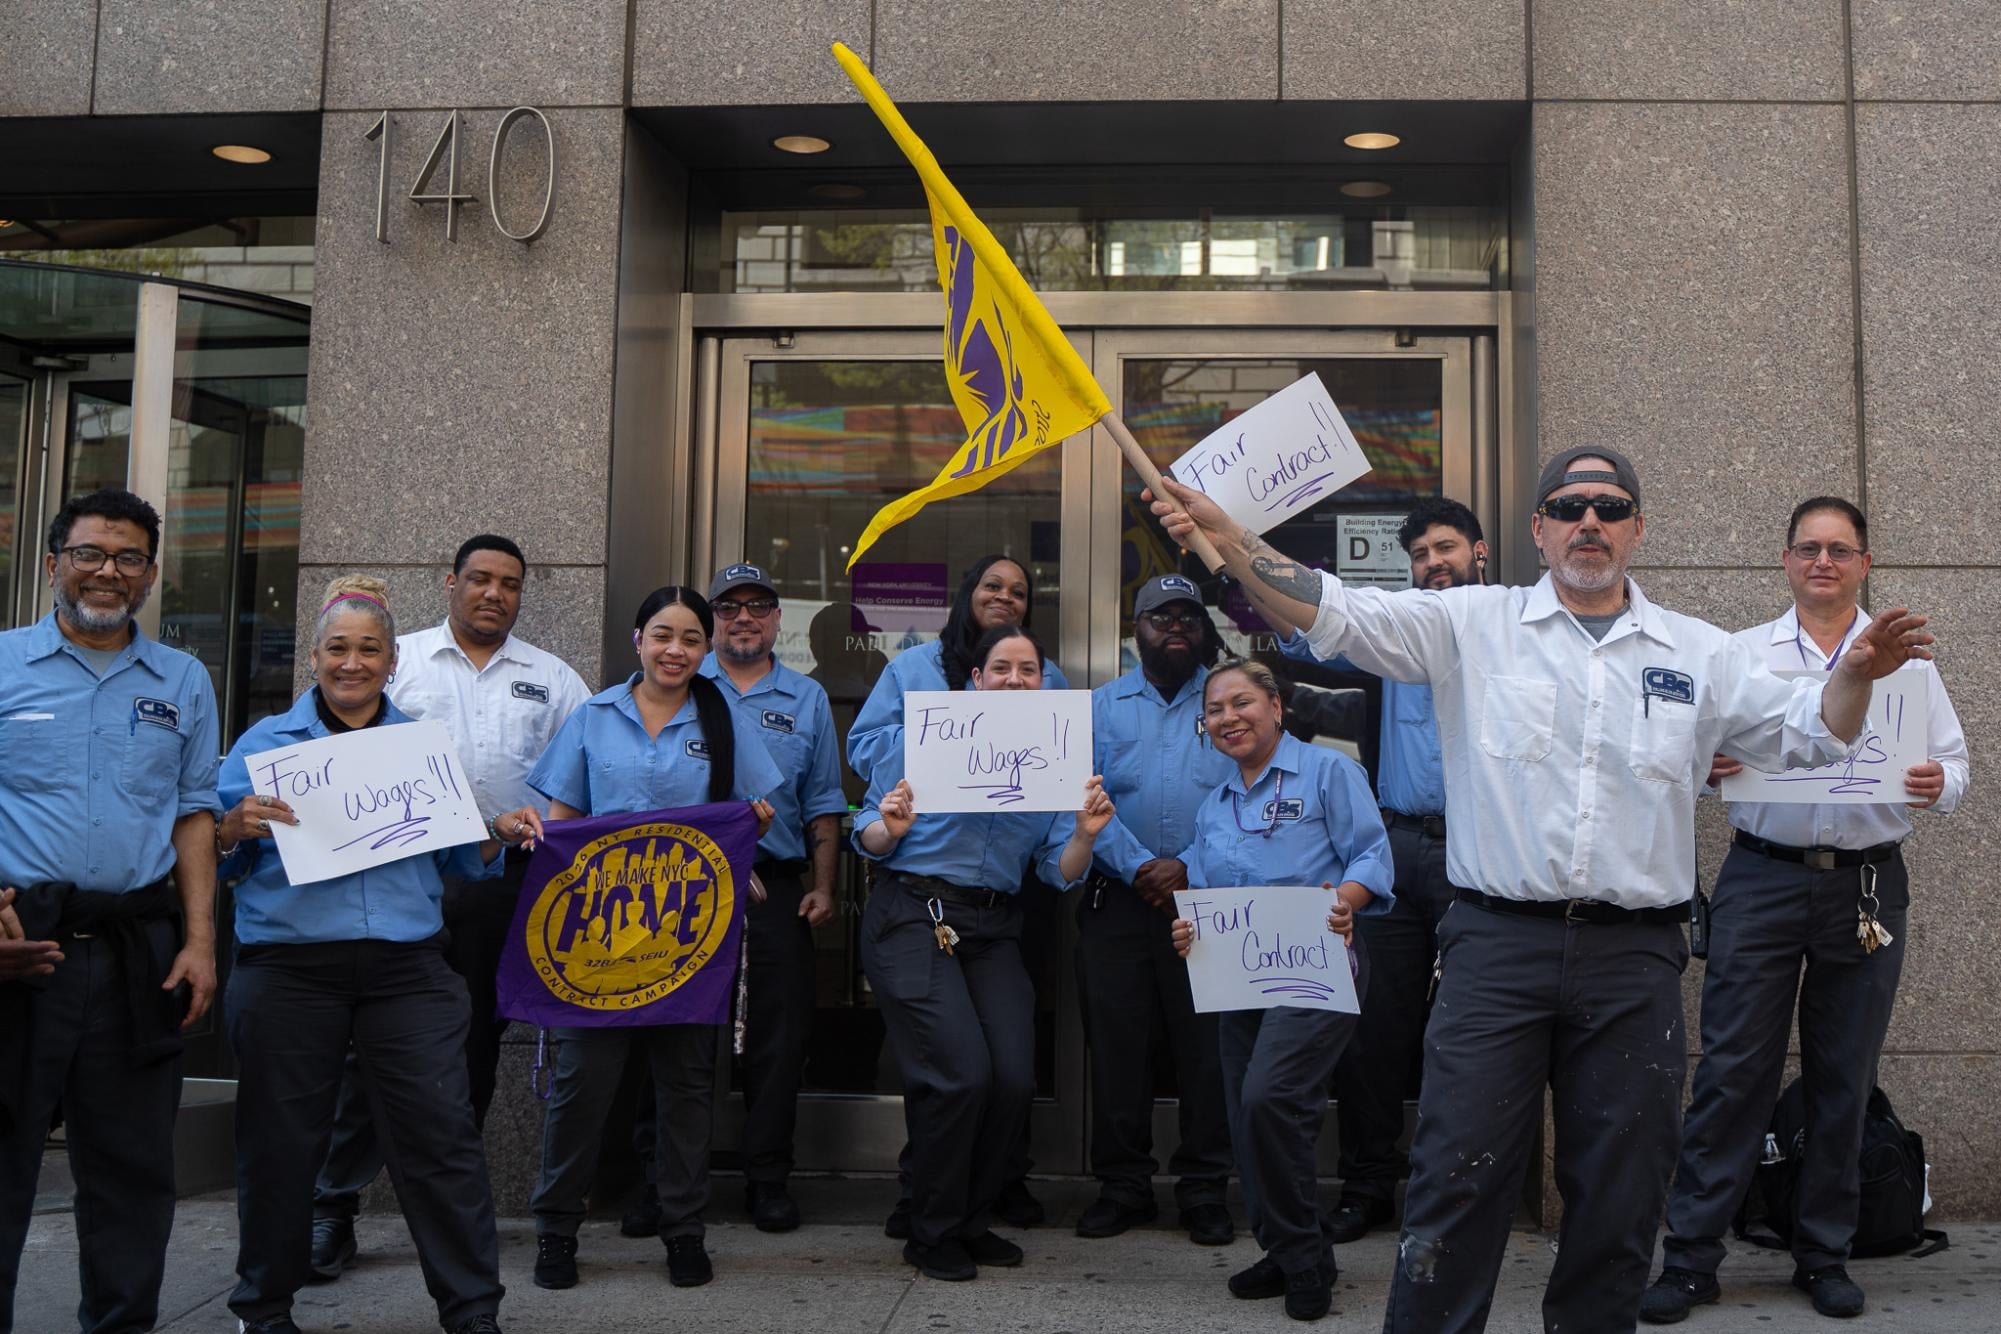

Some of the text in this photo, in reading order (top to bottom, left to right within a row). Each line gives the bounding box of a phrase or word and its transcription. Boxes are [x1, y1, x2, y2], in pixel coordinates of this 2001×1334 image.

[364, 106, 558, 244] 140
[1182, 432, 1246, 493] Fair
[1343, 528, 1380, 537] Efficiency
[1345, 519, 1403, 528] Building Energy
[1349, 536, 1371, 561] D
[1381, 542, 1393, 552] 51
[855, 596, 944, 607] Help Conserve Energy
[514, 682, 547, 701] CBS
[1646, 671, 1691, 700] CBS
[137, 699, 178, 726] CBS
[763, 711, 794, 733] CBS
[917, 706, 984, 746] Fair
[256, 754, 334, 801] Fair
[555, 826, 730, 886] 2026 NY RESIDENTIAL
[595, 863, 689, 890] WE MAKE NYC
[555, 880, 711, 953] HOME
[1184, 899, 1255, 940] Fair
[640, 950, 669, 961] SEIU
[1242, 930, 1329, 971] Contract
[534, 950, 709, 1007] CONTRACT CAMPAIGN
